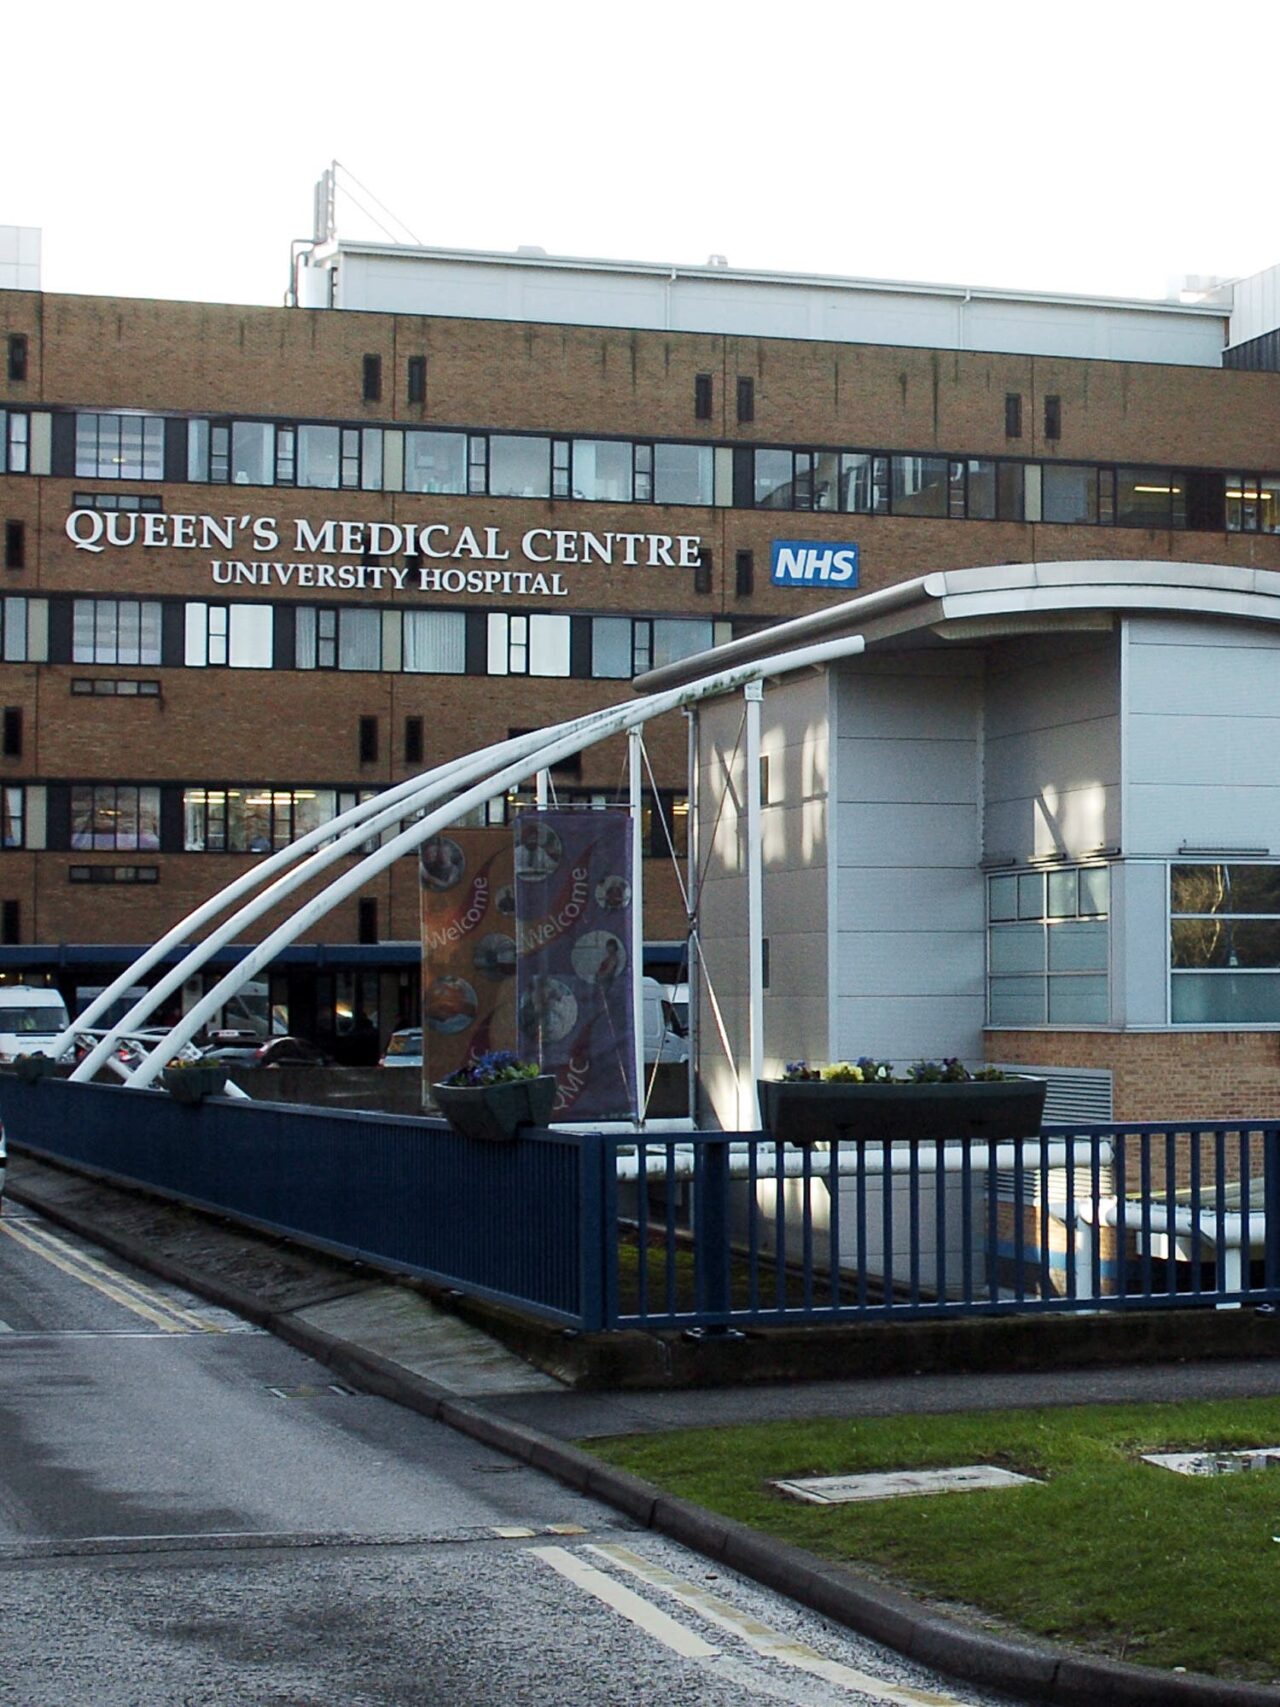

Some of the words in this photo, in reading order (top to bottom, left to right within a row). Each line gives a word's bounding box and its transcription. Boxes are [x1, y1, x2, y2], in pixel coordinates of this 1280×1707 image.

[65, 509, 280, 552] QUEEN'S
[293, 518, 509, 560] MEDICAL
[521, 529, 702, 568] CENTRE
[775, 548, 855, 581] NHS
[211, 560, 409, 590] UNIVERSITY
[418, 568, 568, 596] HOSPITAL
[425, 876, 489, 950] Welcome
[522, 867, 588, 950] Welcome
